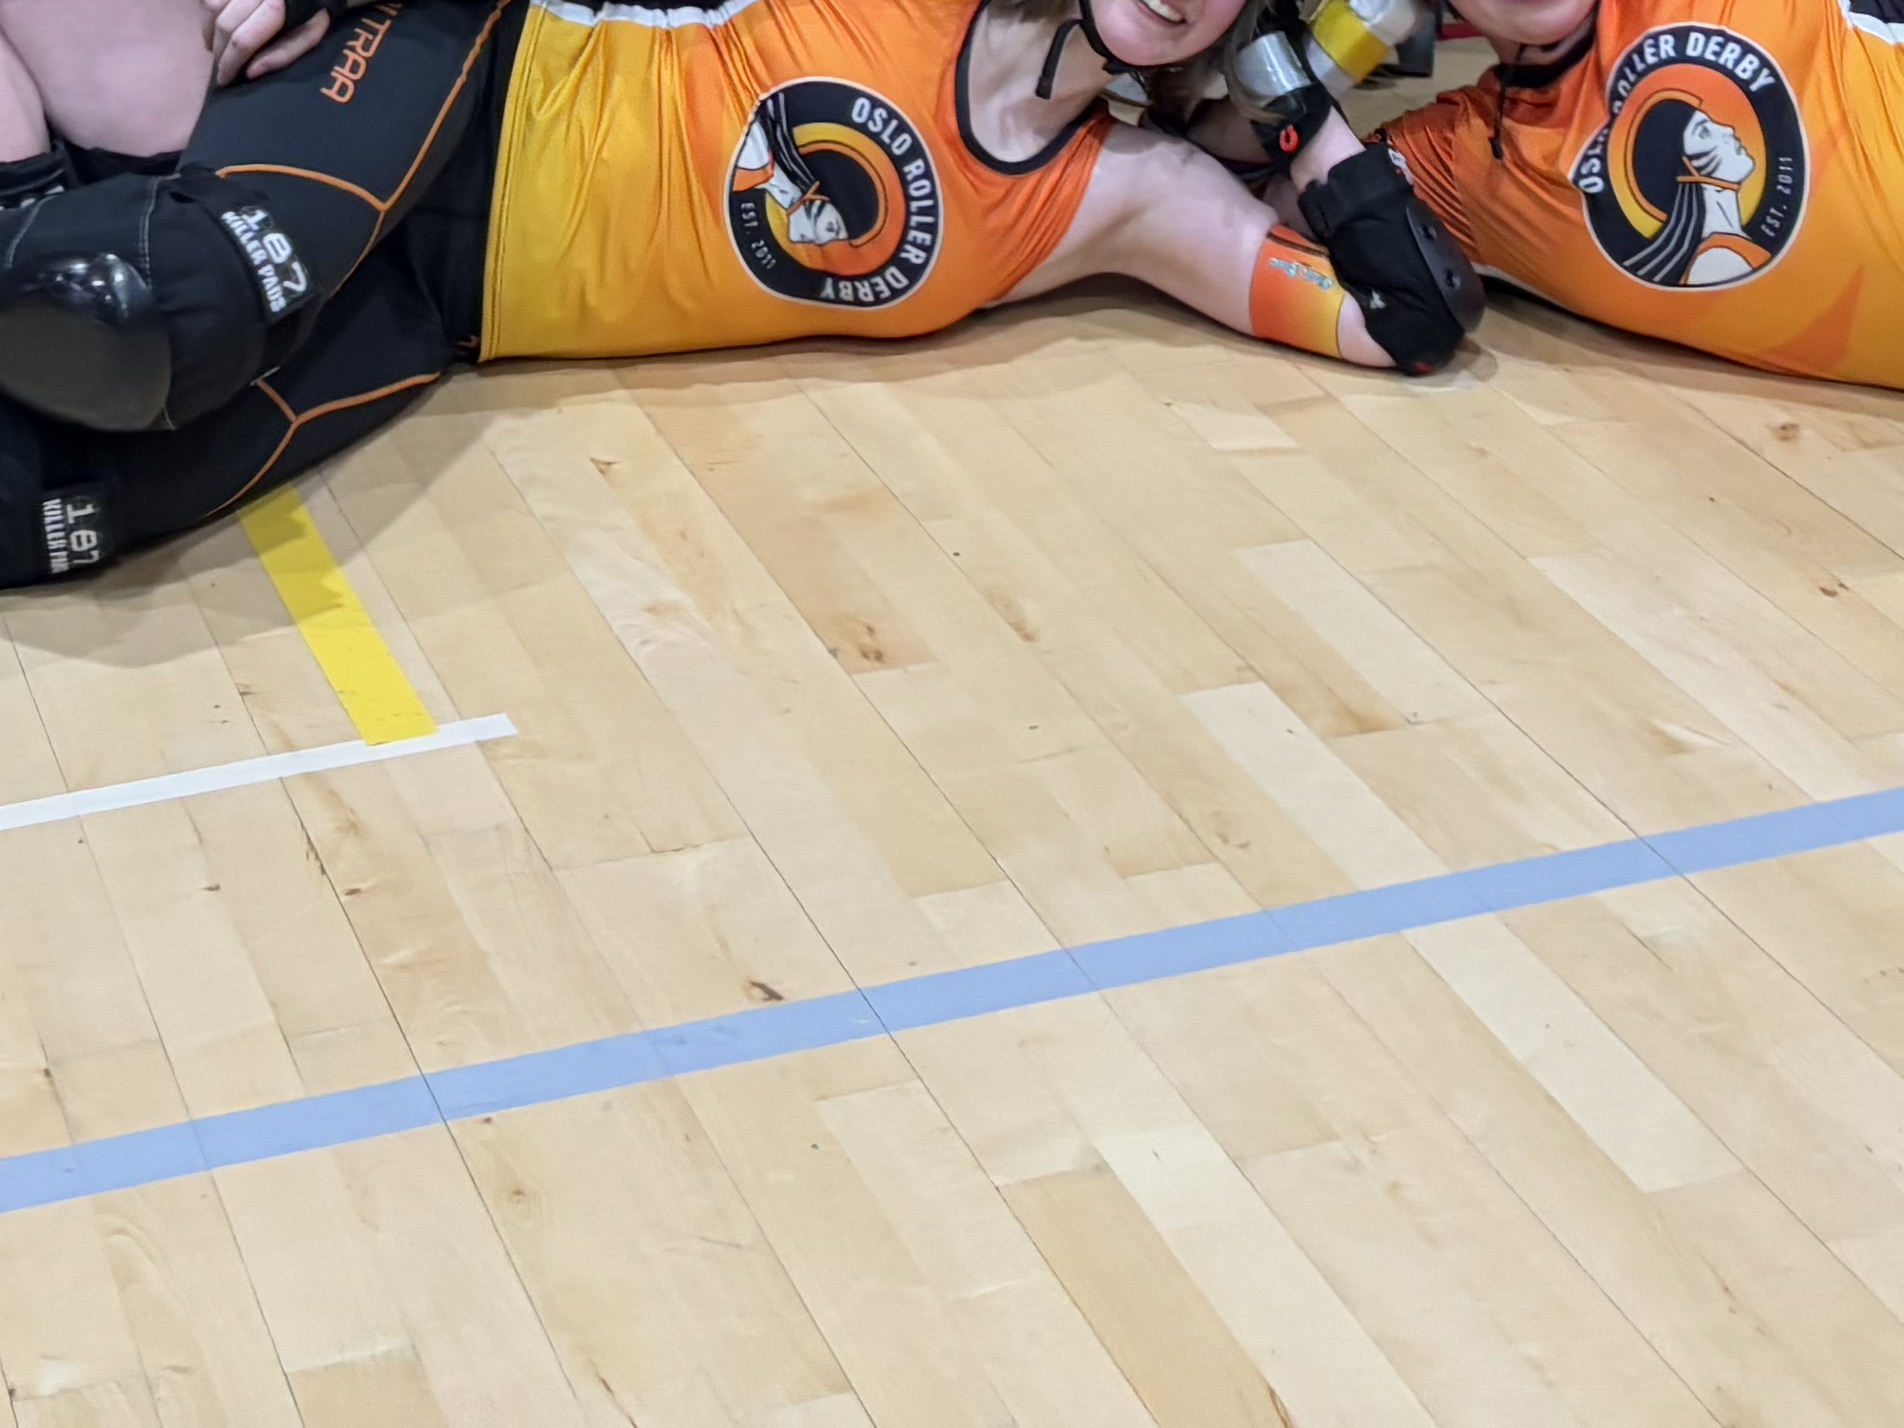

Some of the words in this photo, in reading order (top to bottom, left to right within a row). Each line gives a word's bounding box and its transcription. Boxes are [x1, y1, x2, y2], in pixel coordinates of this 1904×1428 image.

[320, 18, 392, 105] TRAA
[1686, 31, 1776, 93] DERBY
[851, 97, 913, 156] OSLO
[899, 158, 935, 266] ROLLER
[241, 209, 307, 293] 187
[819, 265, 910, 303] DERBY
